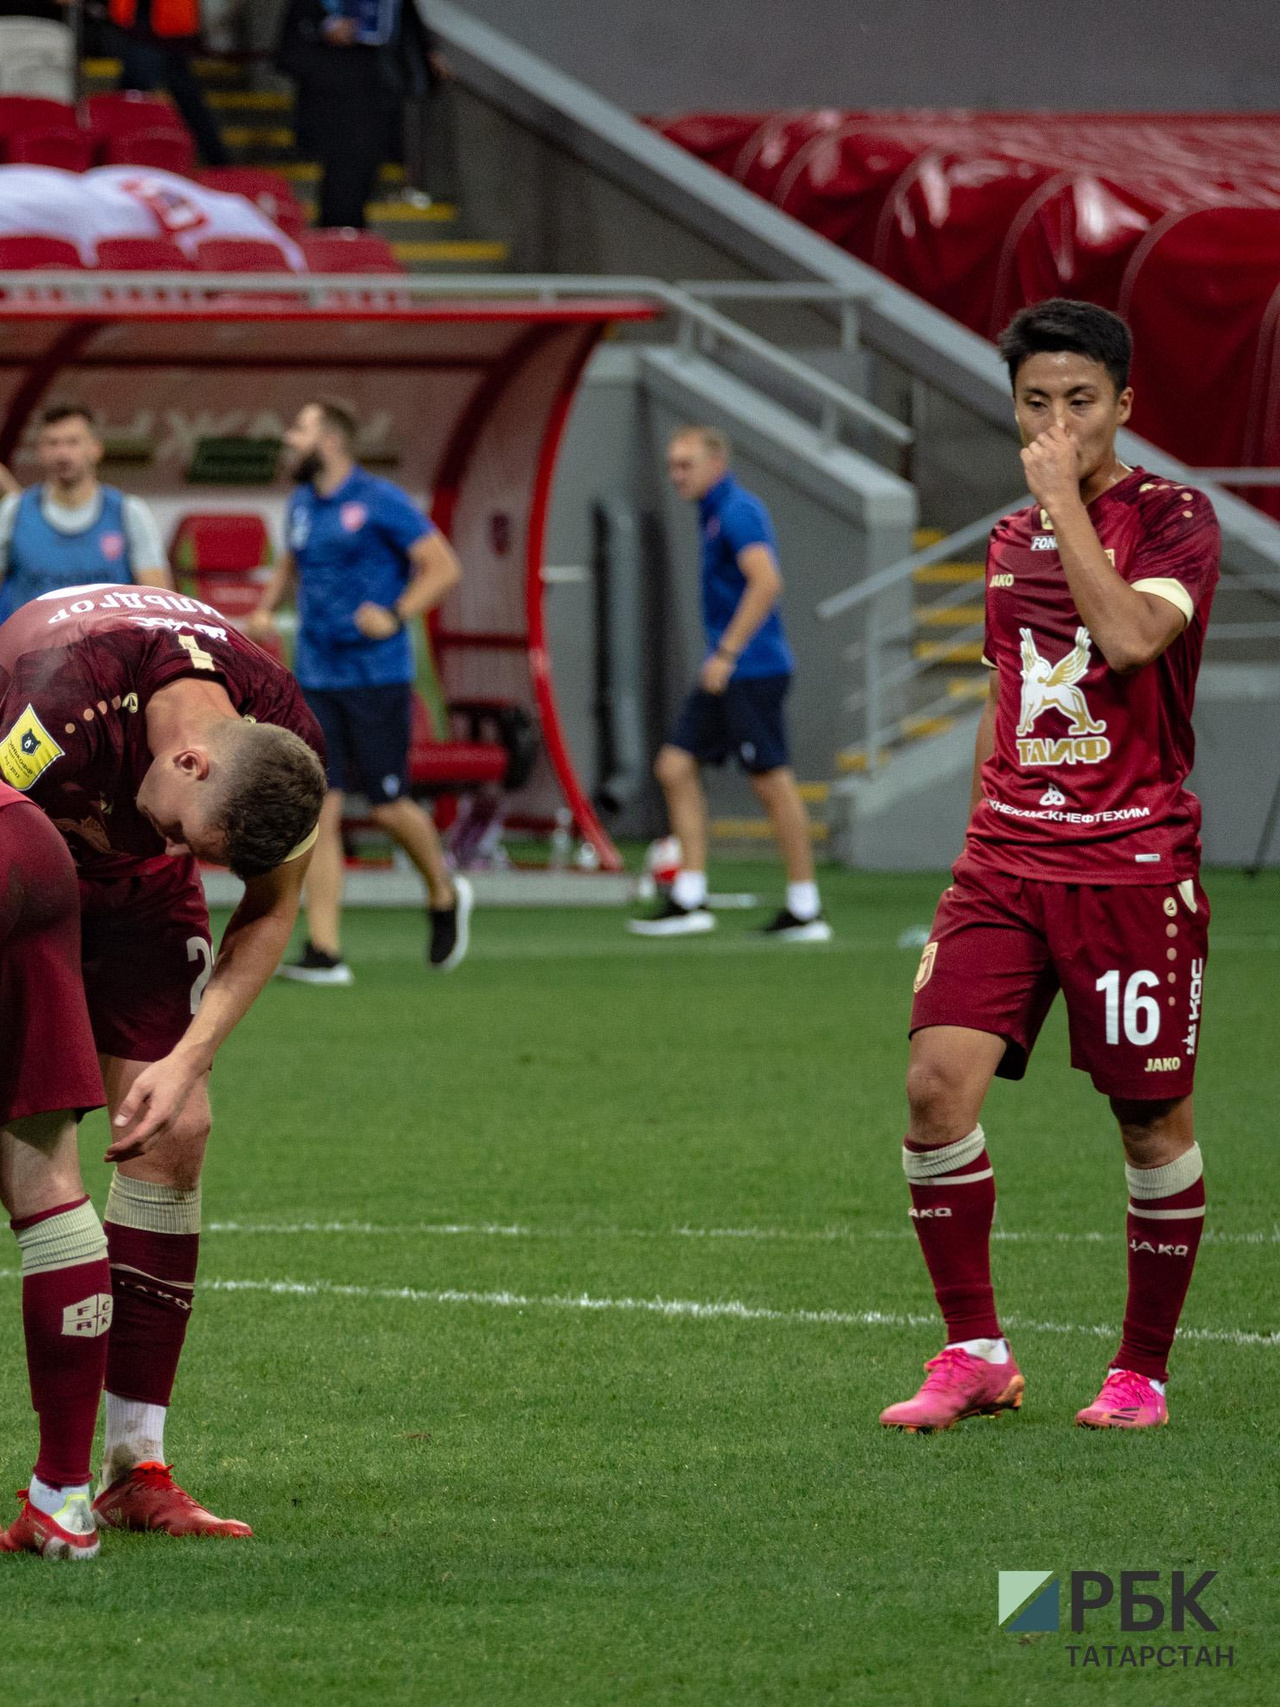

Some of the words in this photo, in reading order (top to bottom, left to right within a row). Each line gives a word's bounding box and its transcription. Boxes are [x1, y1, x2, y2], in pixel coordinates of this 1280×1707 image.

[1016, 737, 1111, 766] ТАИФ
[1096, 970, 1160, 1046] 16
[1144, 1057, 1181, 1072] JAKO
[1130, 1239, 1189, 1257] JAKO
